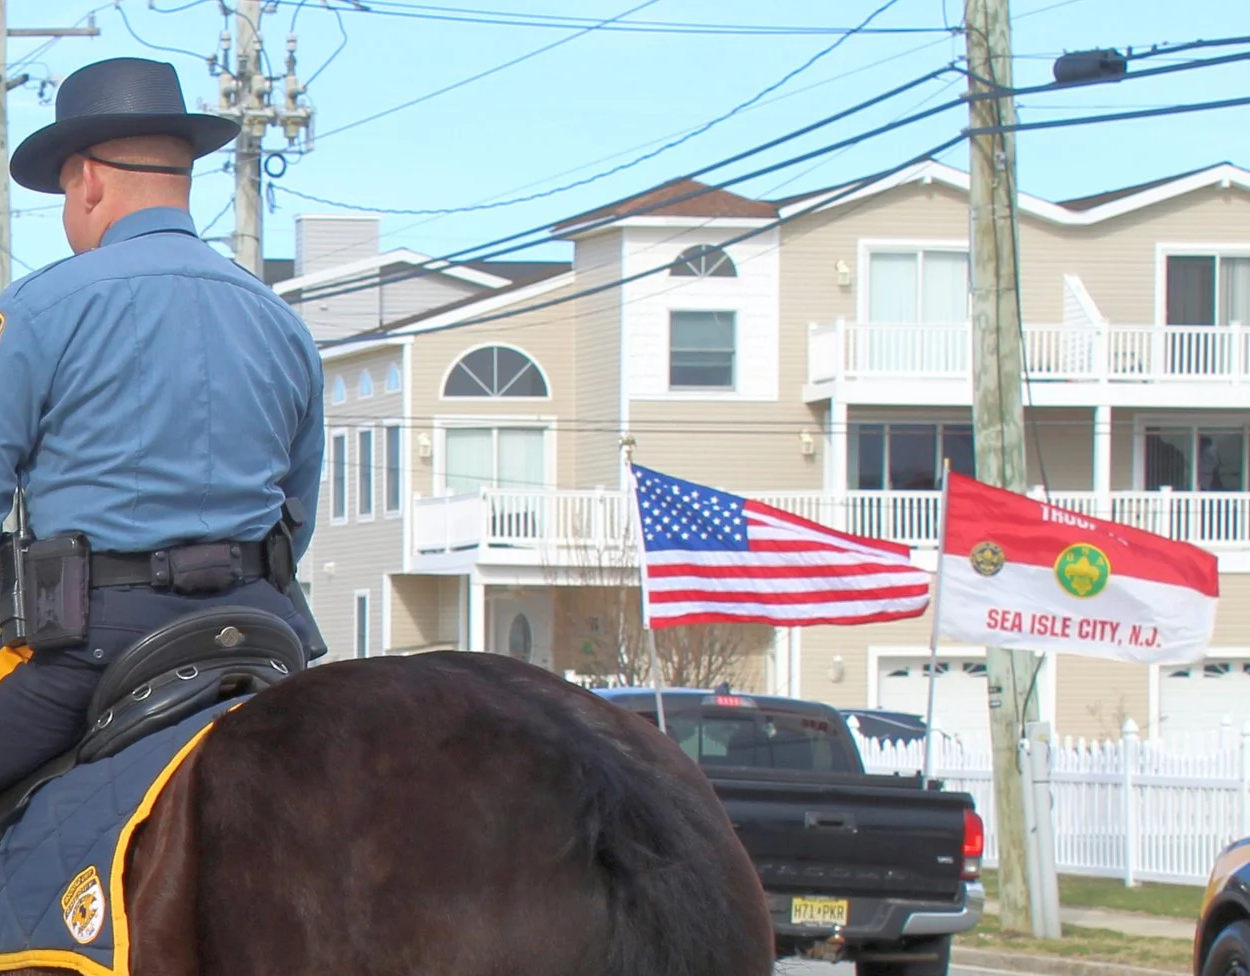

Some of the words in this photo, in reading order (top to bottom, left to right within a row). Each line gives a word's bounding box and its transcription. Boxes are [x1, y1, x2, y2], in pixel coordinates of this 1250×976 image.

[986, 608, 1023, 633] SEA
[1030, 613, 1072, 638] ISLE
[1077, 618, 1123, 646] CITY,
[1128, 624, 1162, 648] N.J.
